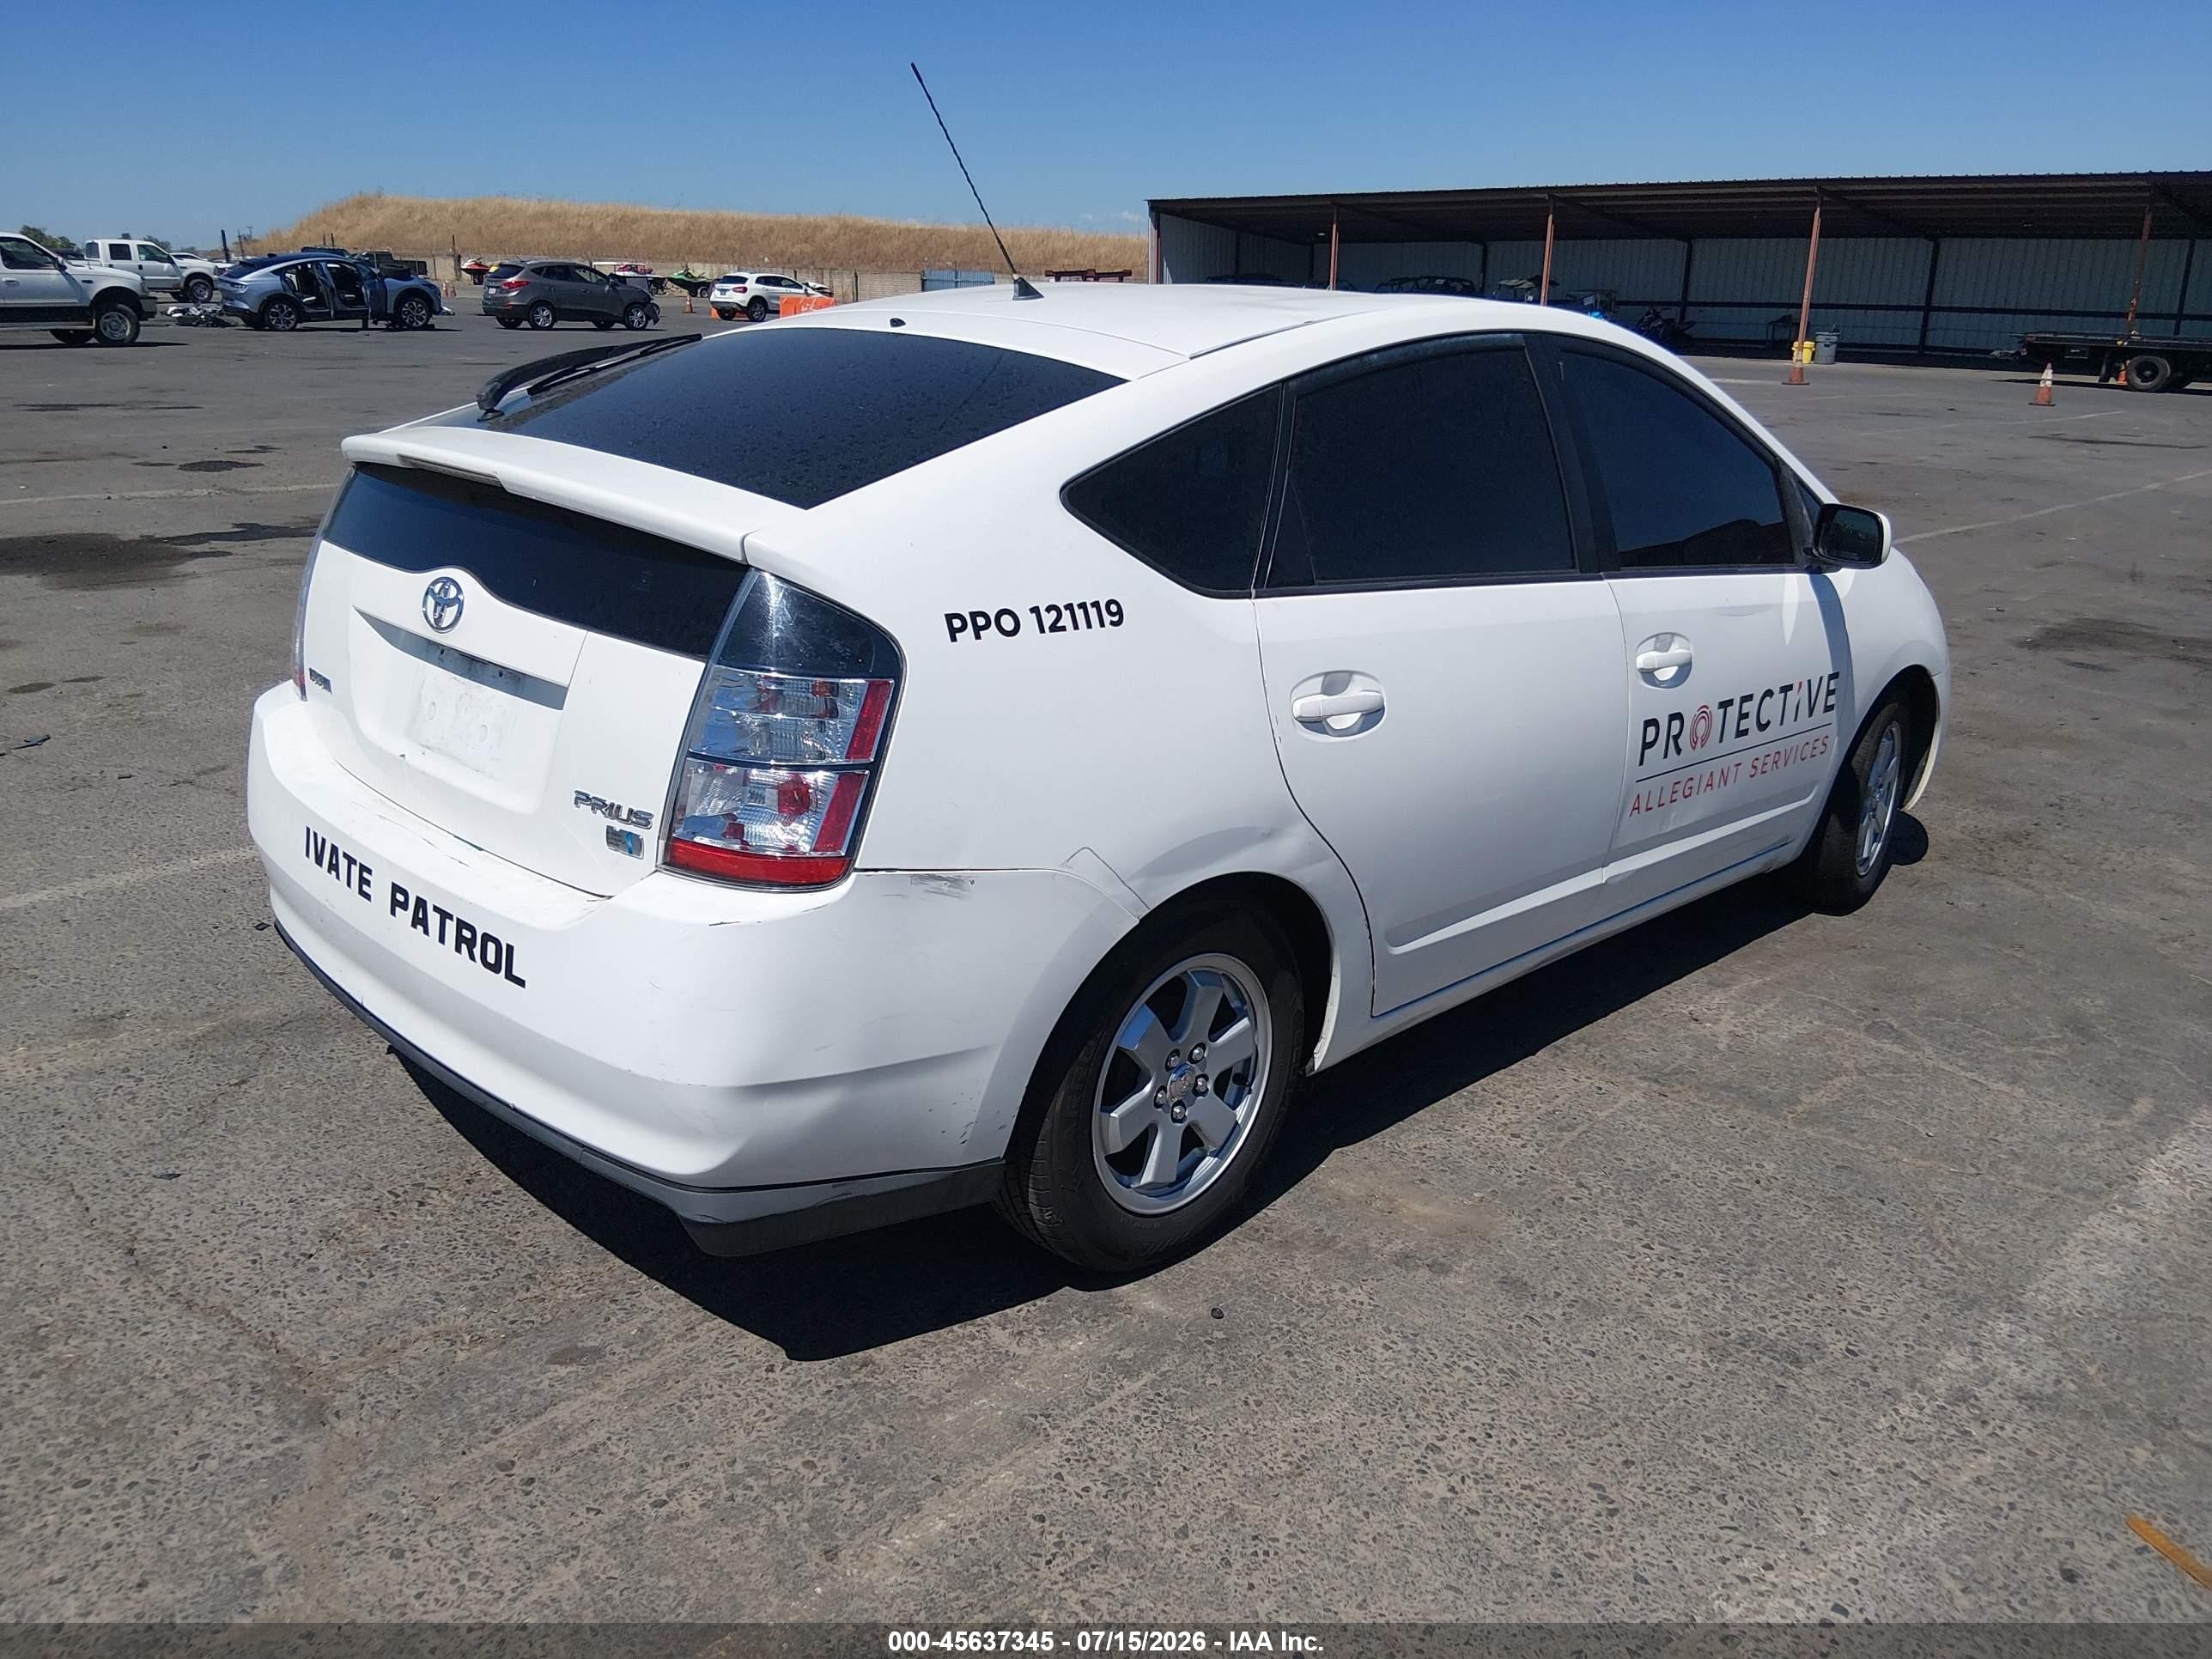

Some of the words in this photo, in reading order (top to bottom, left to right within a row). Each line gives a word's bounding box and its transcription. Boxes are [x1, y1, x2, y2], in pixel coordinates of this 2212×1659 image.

[944, 608, 1021, 643] PPO
[1029, 599, 1124, 634] 121119
[1638, 672, 1839, 767] PROTECTIVE
[574, 789, 654, 830] PRIUS
[1629, 763, 1742, 817] ALLEGIANT
[1749, 735, 1830, 778] SERVICES
[305, 825, 373, 902] IVATE
[390, 881, 526, 989] PATROL
